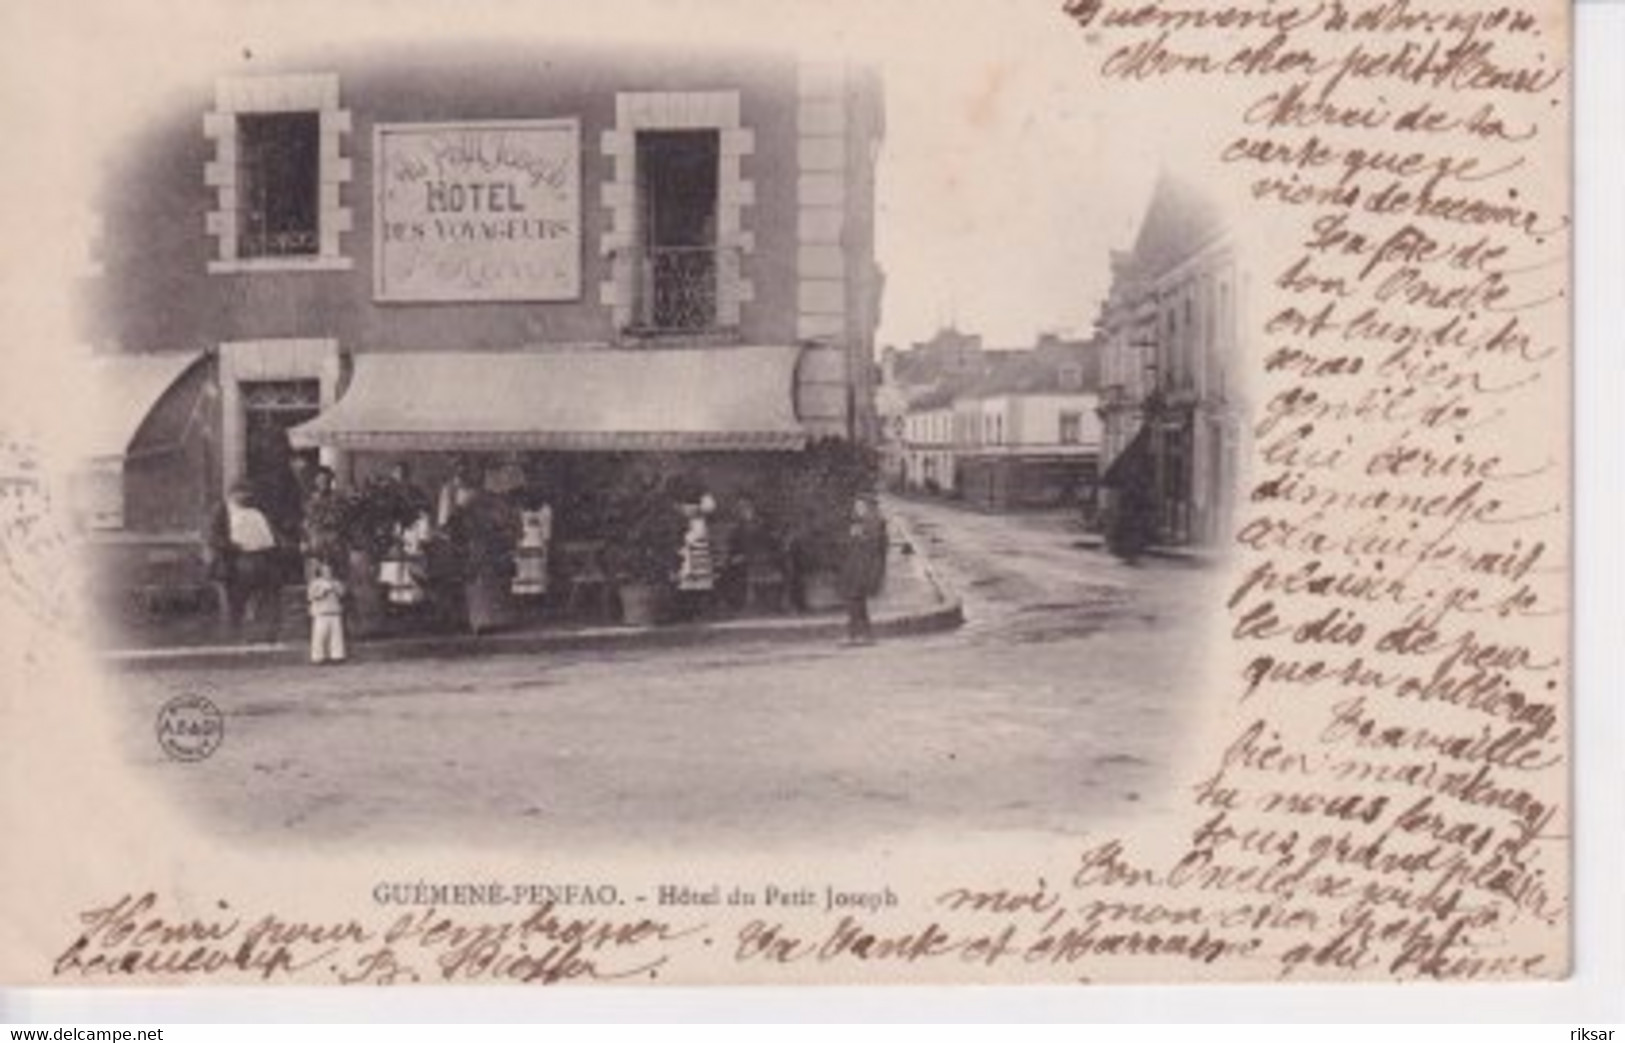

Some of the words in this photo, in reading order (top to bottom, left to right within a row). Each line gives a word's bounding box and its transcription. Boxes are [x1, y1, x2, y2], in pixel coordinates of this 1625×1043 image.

[425, 181, 526, 213] HOTEL
[658, 884, 720, 906] Hôtel
[727, 884, 756, 906] du
[765, 884, 816, 906] Petit
[825, 884, 899, 913] Joseph
